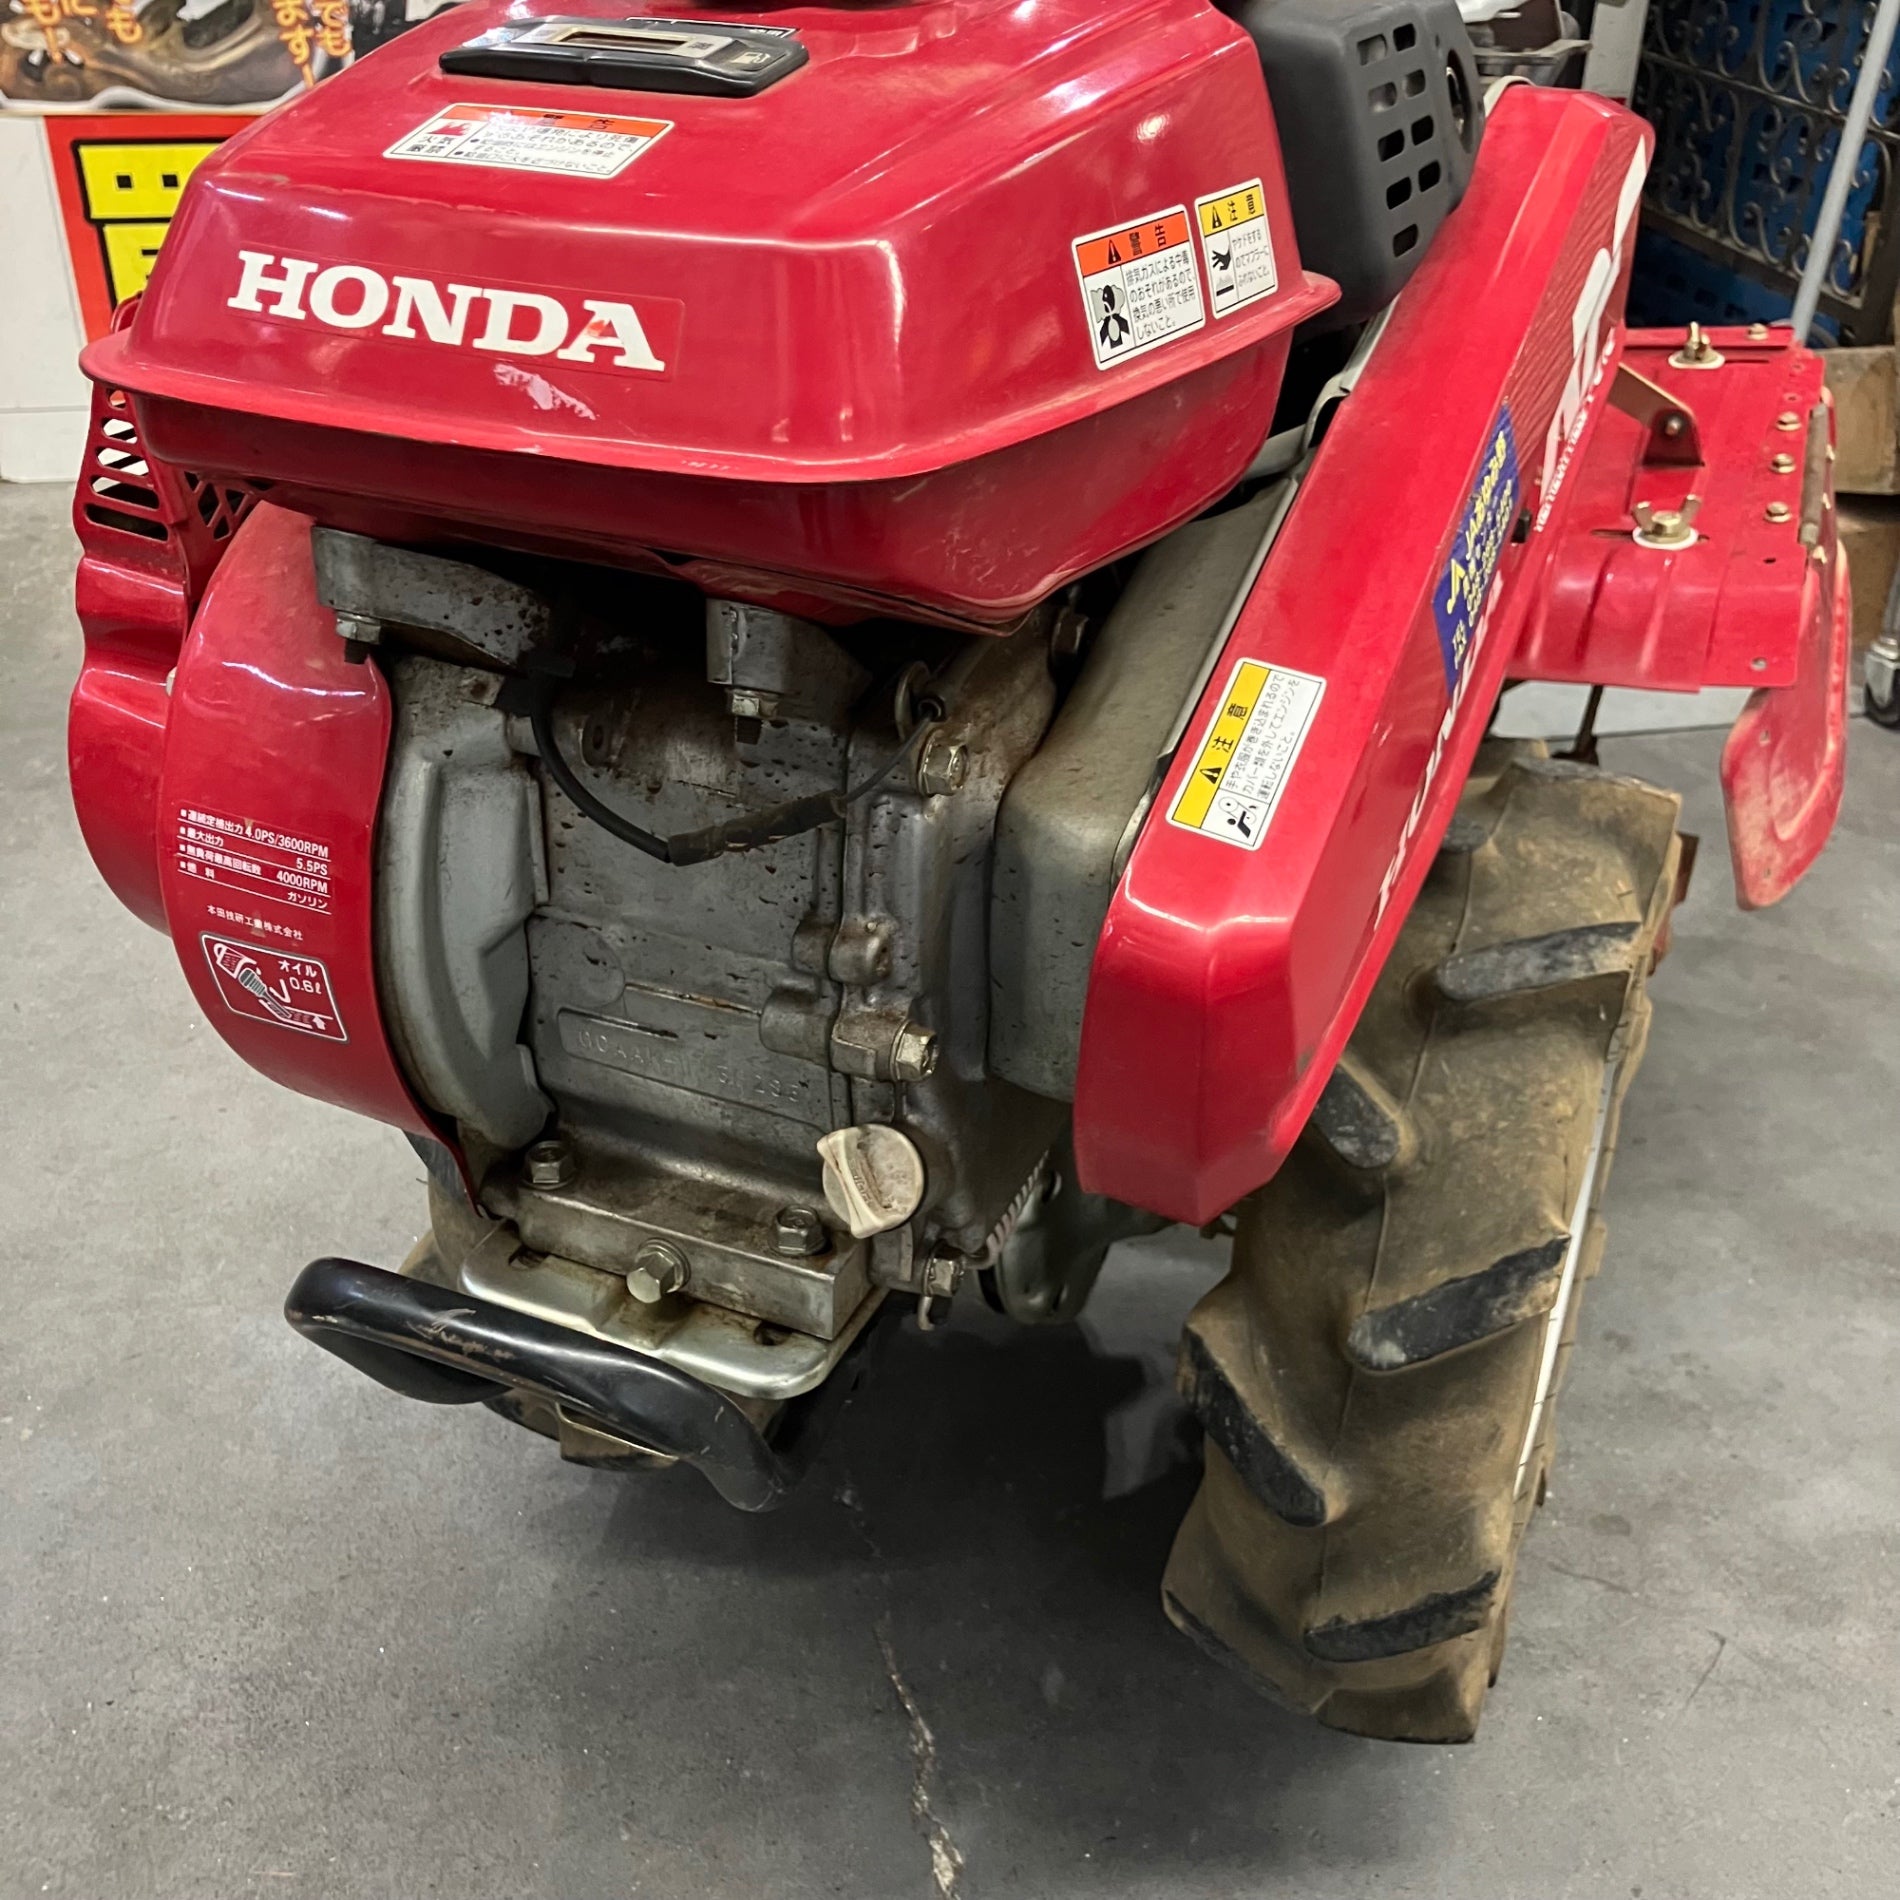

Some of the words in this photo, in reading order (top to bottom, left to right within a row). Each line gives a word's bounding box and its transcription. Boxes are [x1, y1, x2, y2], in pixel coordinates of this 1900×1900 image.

[1128, 223, 1168, 257] 警告
[227, 249, 666, 372] HONDA
[1211, 702, 1249, 754] 注意
[244, 825, 330, 859] 4.0PS/3600RPM
[276, 869, 329, 894] 4000RPM
[295, 857, 329, 877] 5.5PS
[286, 891, 329, 910] ガソリン
[277, 959, 318, 978] オイル
